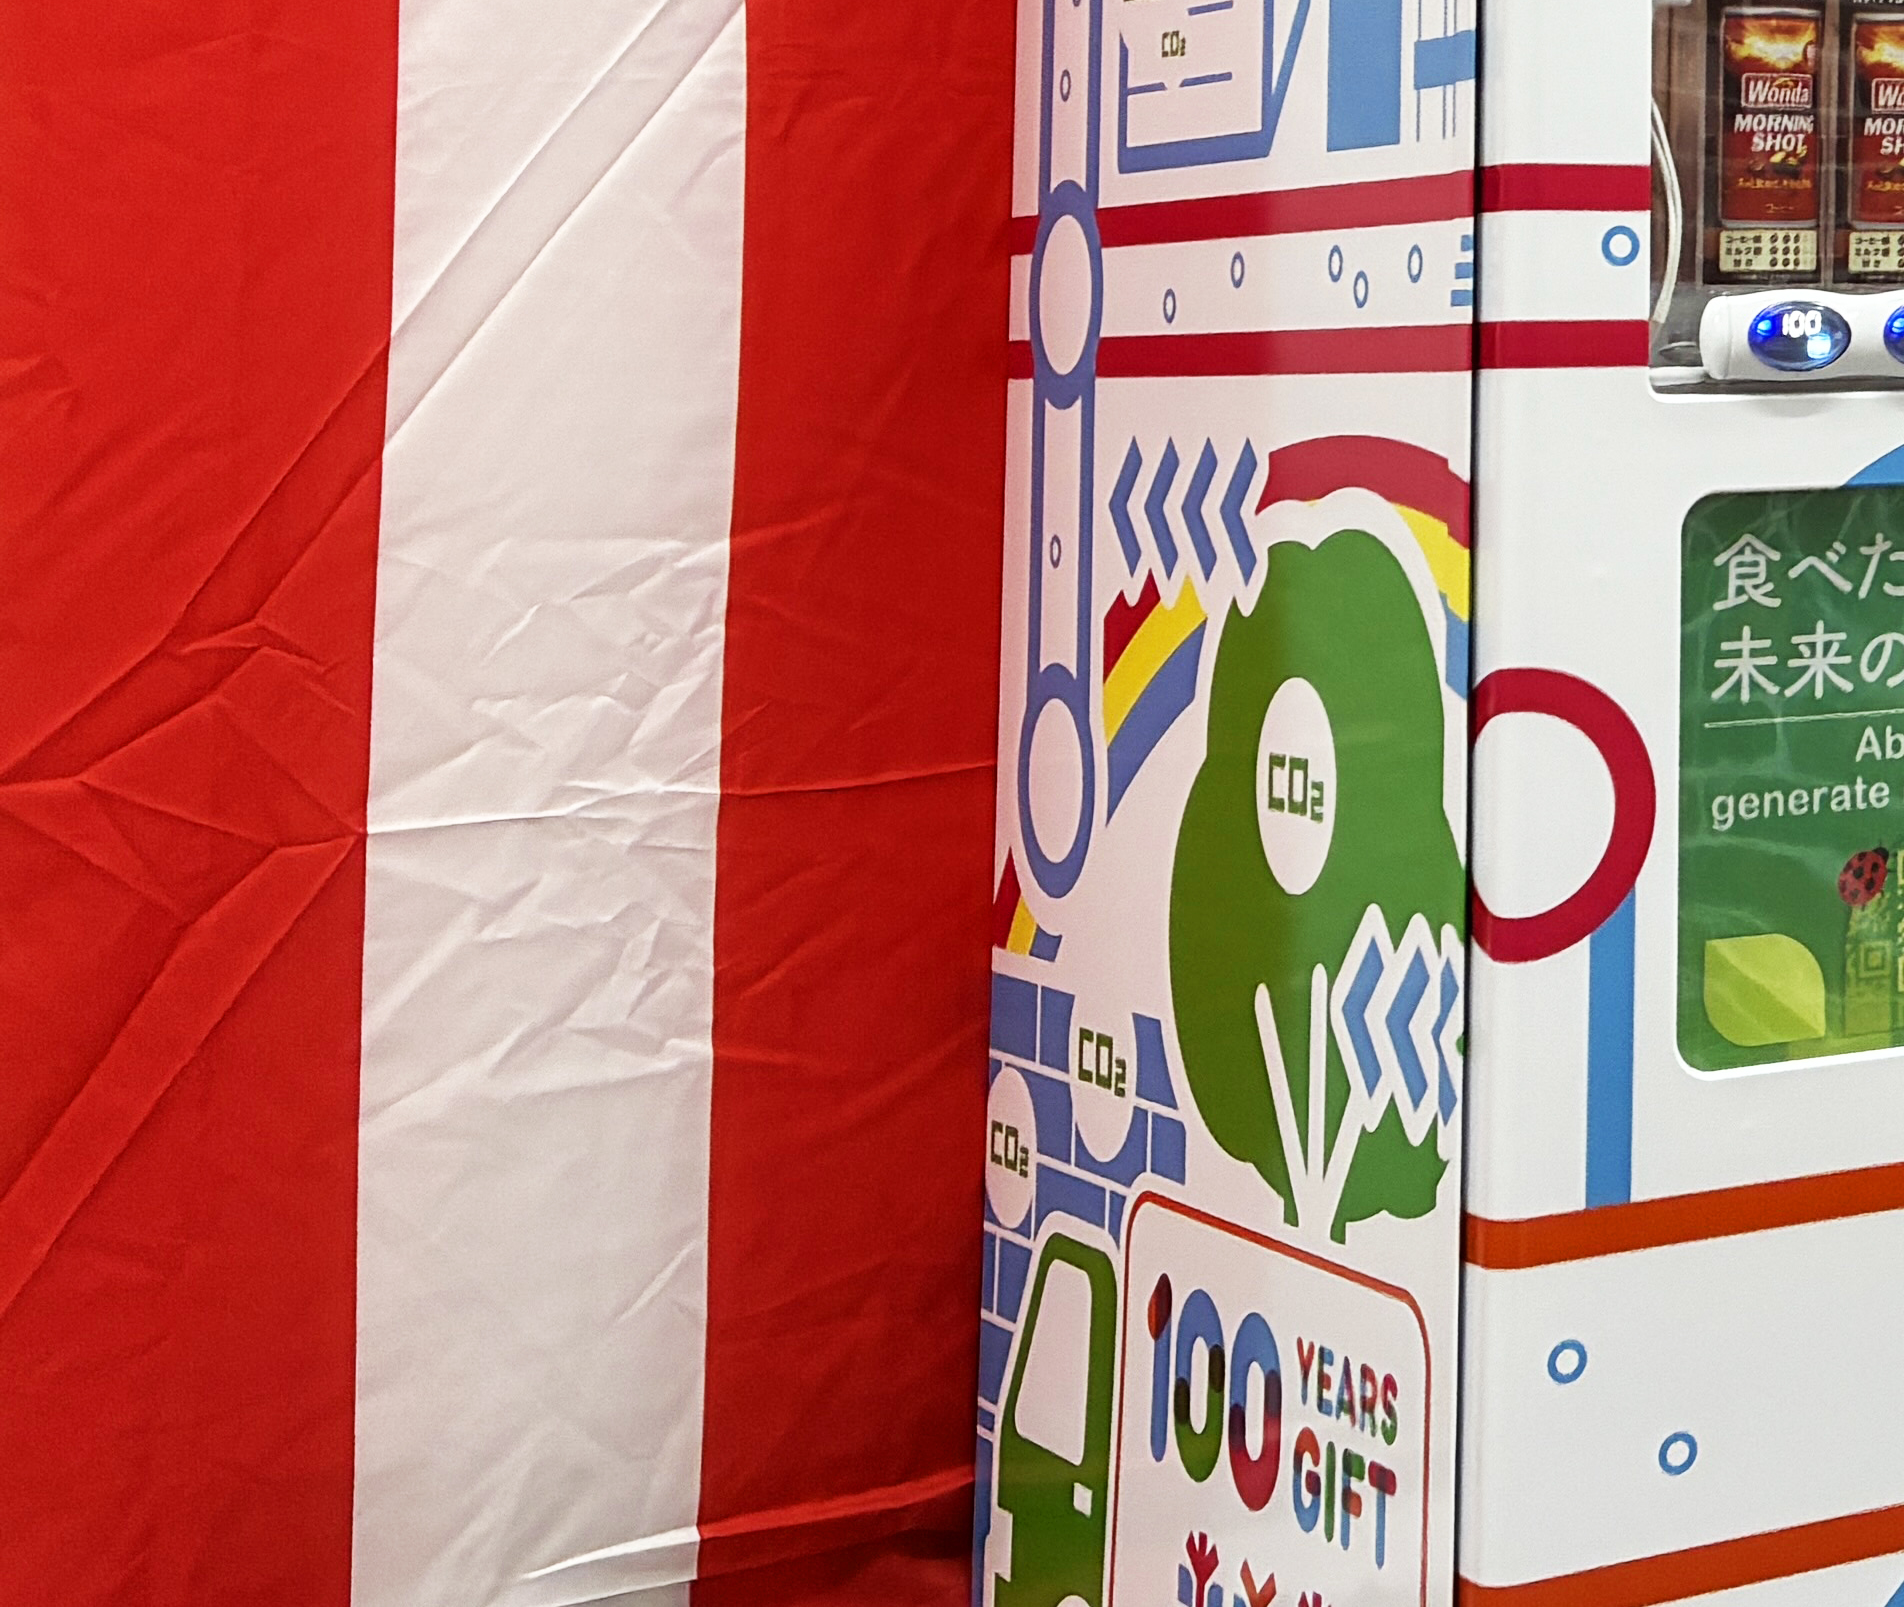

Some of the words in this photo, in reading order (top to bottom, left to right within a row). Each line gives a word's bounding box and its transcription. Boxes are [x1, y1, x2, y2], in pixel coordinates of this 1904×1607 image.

[1161, 30, 1187, 58] CO2
[1748, 80, 1810, 105] Wonda
[1734, 114, 1814, 135] MORNING
[1751, 133, 1806, 154] SHOT
[1782, 309, 1822, 339] 100
[1267, 752, 1325, 824] CO2
[1711, 774, 1891, 831] generate
[1078, 1026, 1128, 1098] CO2
[989, 1120, 1030, 1179] CO2
[1147, 1273, 1283, 1512] 100
[1296, 1335, 1399, 1446] YEARS
[1292, 1426, 1398, 1570] GIFT
